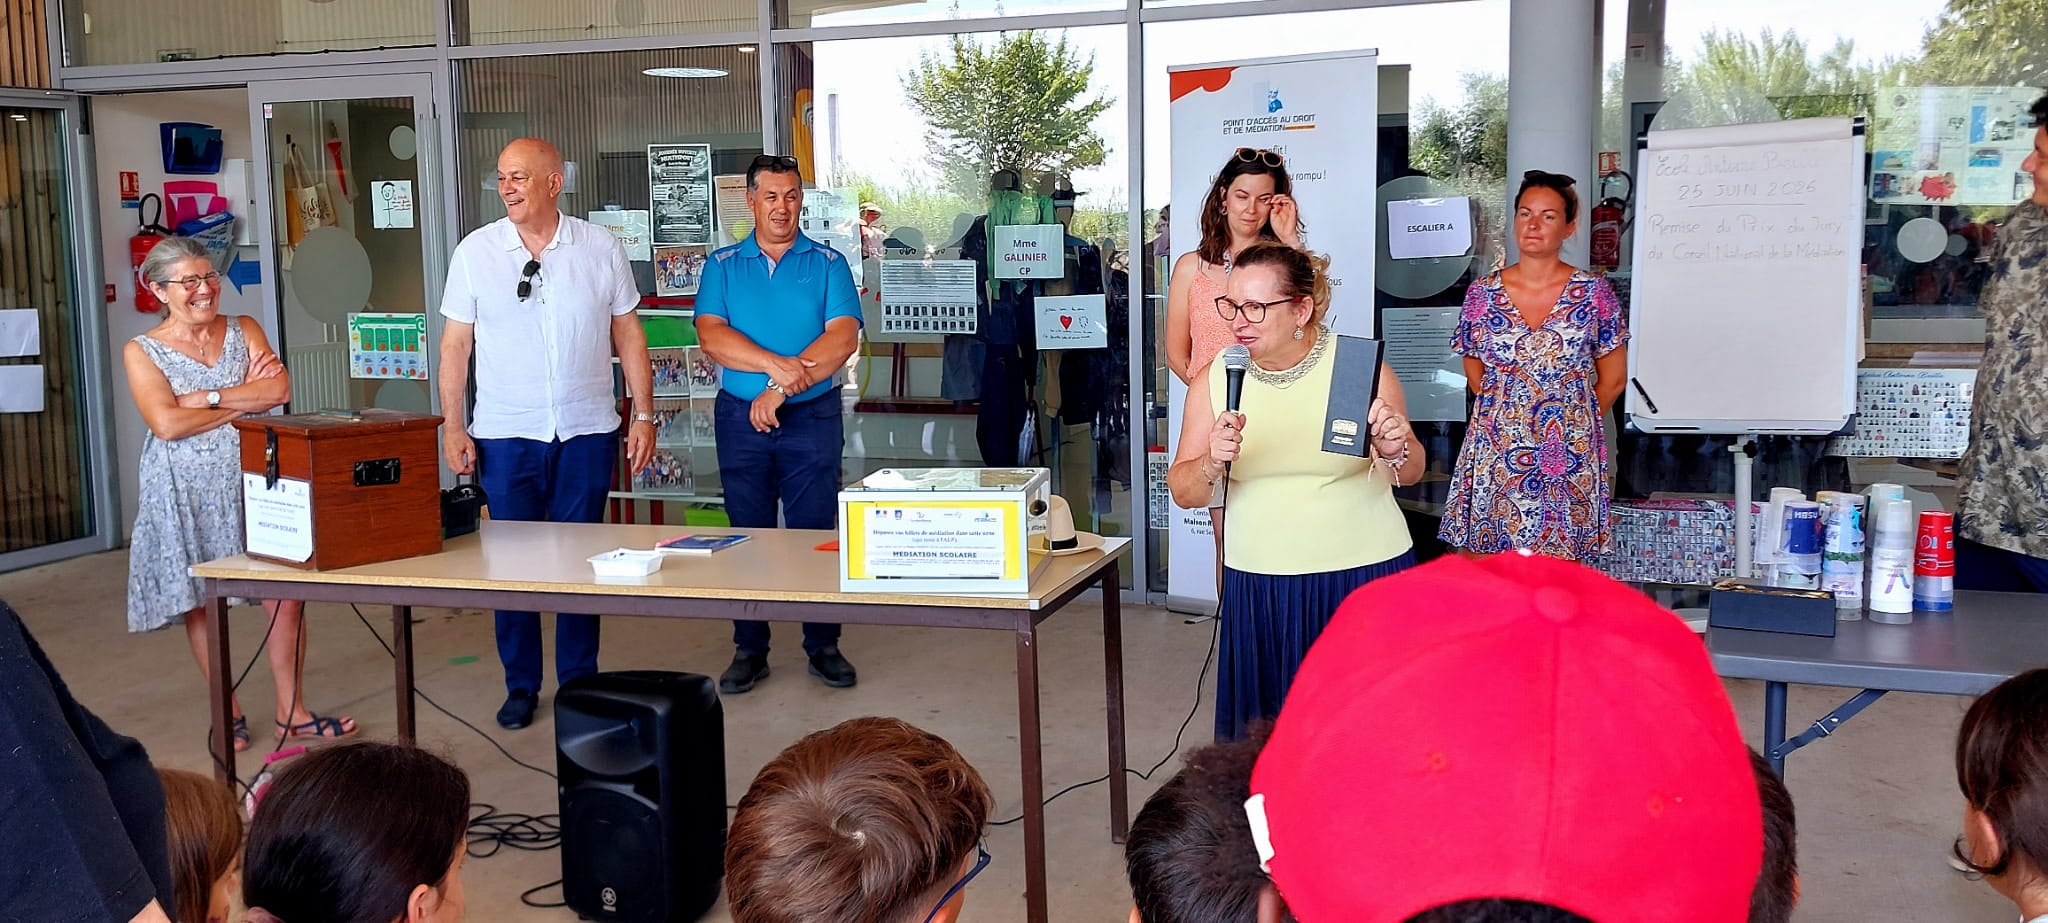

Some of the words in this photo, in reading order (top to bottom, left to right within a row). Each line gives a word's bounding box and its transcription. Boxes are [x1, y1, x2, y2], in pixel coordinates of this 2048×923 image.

[1223, 119, 1244, 127] POINT
[1280, 115, 1291, 123] AU
[1293, 114, 1315, 122] DROIT
[1234, 126, 1243, 134] DE
[1245, 124, 1285, 133] MÉDIATION
[1296, 171, 1322, 182] rompu
[1679, 184, 1703, 200] 25
[1714, 183, 1757, 197] JUIN
[1407, 223, 1446, 233] ESCALIER
[1447, 223, 1454, 231] A
[1648, 214, 1701, 235] Remise
[1716, 217, 1731, 233] du
[1736, 214, 1776, 232] Prix
[1786, 217, 1805, 233] du
[1013, 239, 1037, 248] Mme
[1648, 245, 1663, 259] du
[1004, 253, 1048, 262] GALINIER
[1019, 267, 1031, 275] CP
[1184, 517, 1207, 526] Maison
